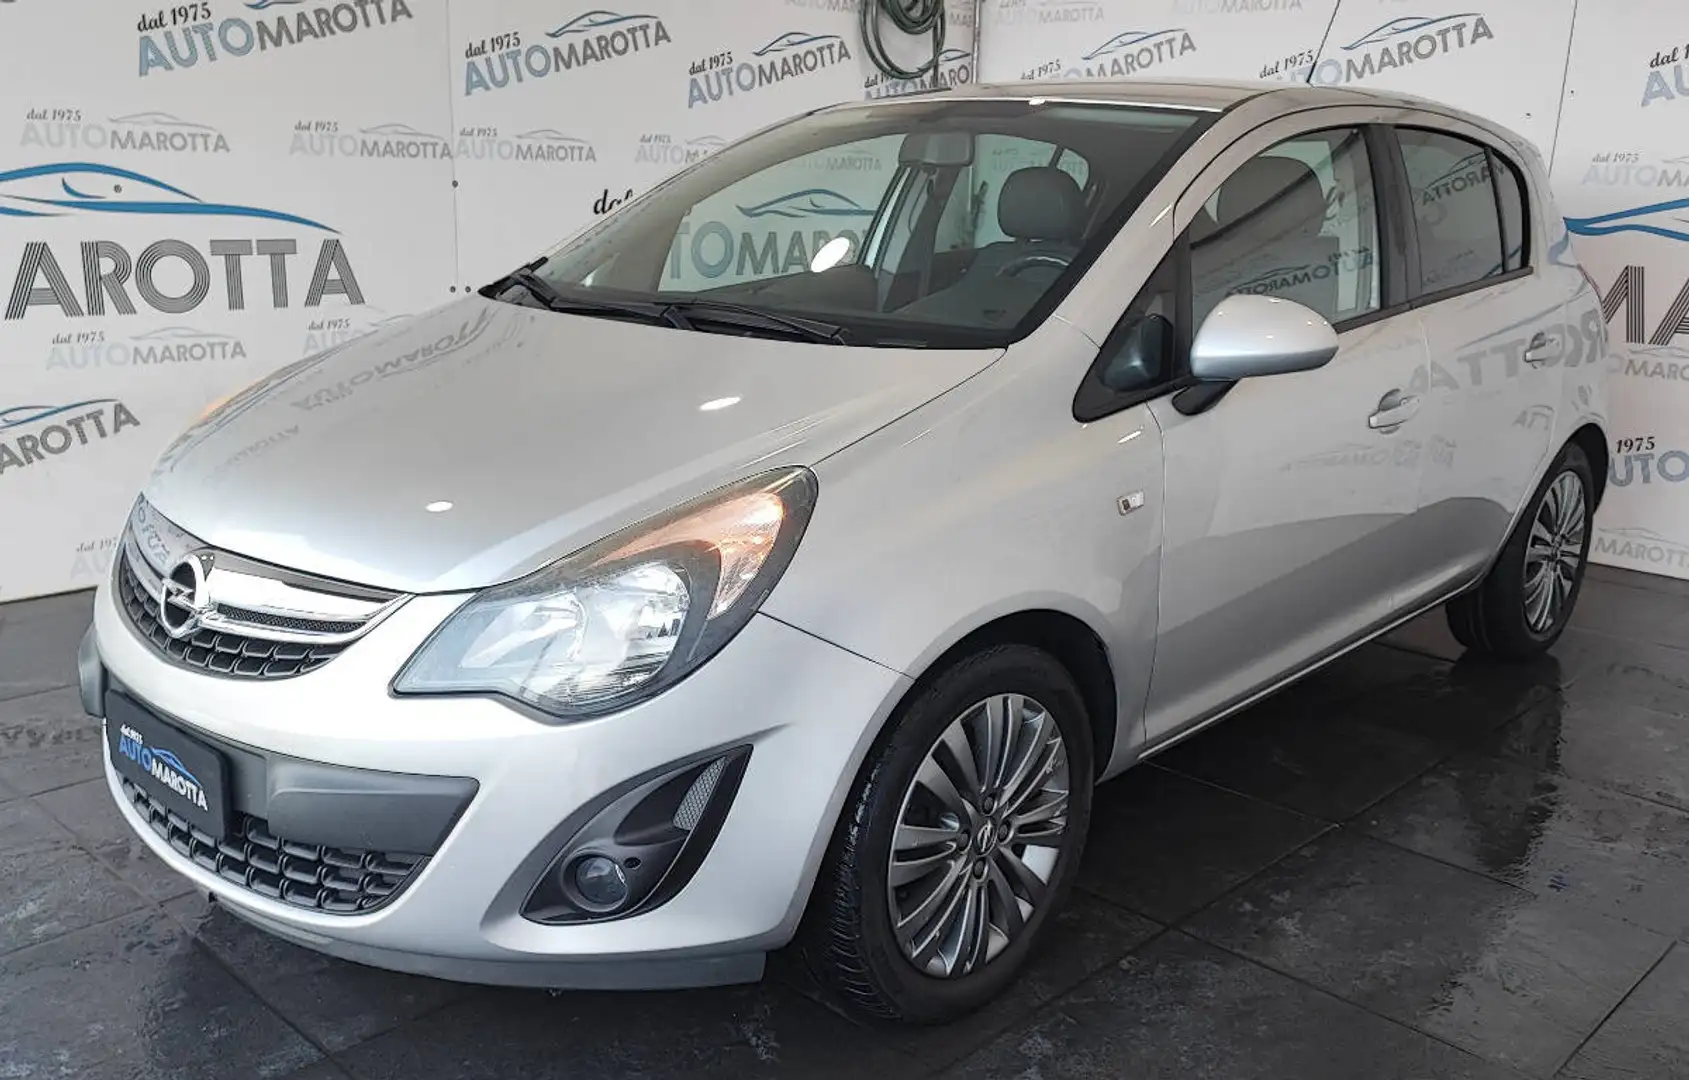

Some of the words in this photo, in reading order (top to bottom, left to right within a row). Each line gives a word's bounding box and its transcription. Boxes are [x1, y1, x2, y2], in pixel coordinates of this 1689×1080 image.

[137, 14, 168, 32] dal
[171, 3, 212, 26] 1975
[139, 0, 414, 77] AUTOMAROTTA
[465, 39, 487, 59] dal
[490, 31, 521, 54] 1975
[465, 20, 671, 96] AUTOMAROTTA
[689, 58, 707, 76] dal
[709, 51, 734, 72] 1975
[1259, 62, 1280, 80] dal
[1284, 48, 1315, 72] 1975
[1649, 46, 1680, 68] dal
[687, 40, 851, 109] AUTOMAROTTA
[26, 108, 49, 121] dal
[51, 107, 82, 122] 1975
[294, 120, 313, 132] dal
[19, 123, 231, 153] AUTOMAROTTA
[289, 133, 451, 160] AUTOMAROTTA
[454, 135, 597, 163] AUTOMAROTTA
[1592, 151, 1611, 163] dal
[1613, 152, 1640, 164] 1975
[4, 238, 367, 321] AROTTA
[52, 330, 73, 345] dal
[76, 330, 105, 344] 1975
[46, 340, 247, 371] AUTOMAROTTA
[1615, 436, 1657, 454] 1975
[1594, 536, 1689, 568] MAROTT
[119, 734, 208, 812] AUTOMAROTTA
